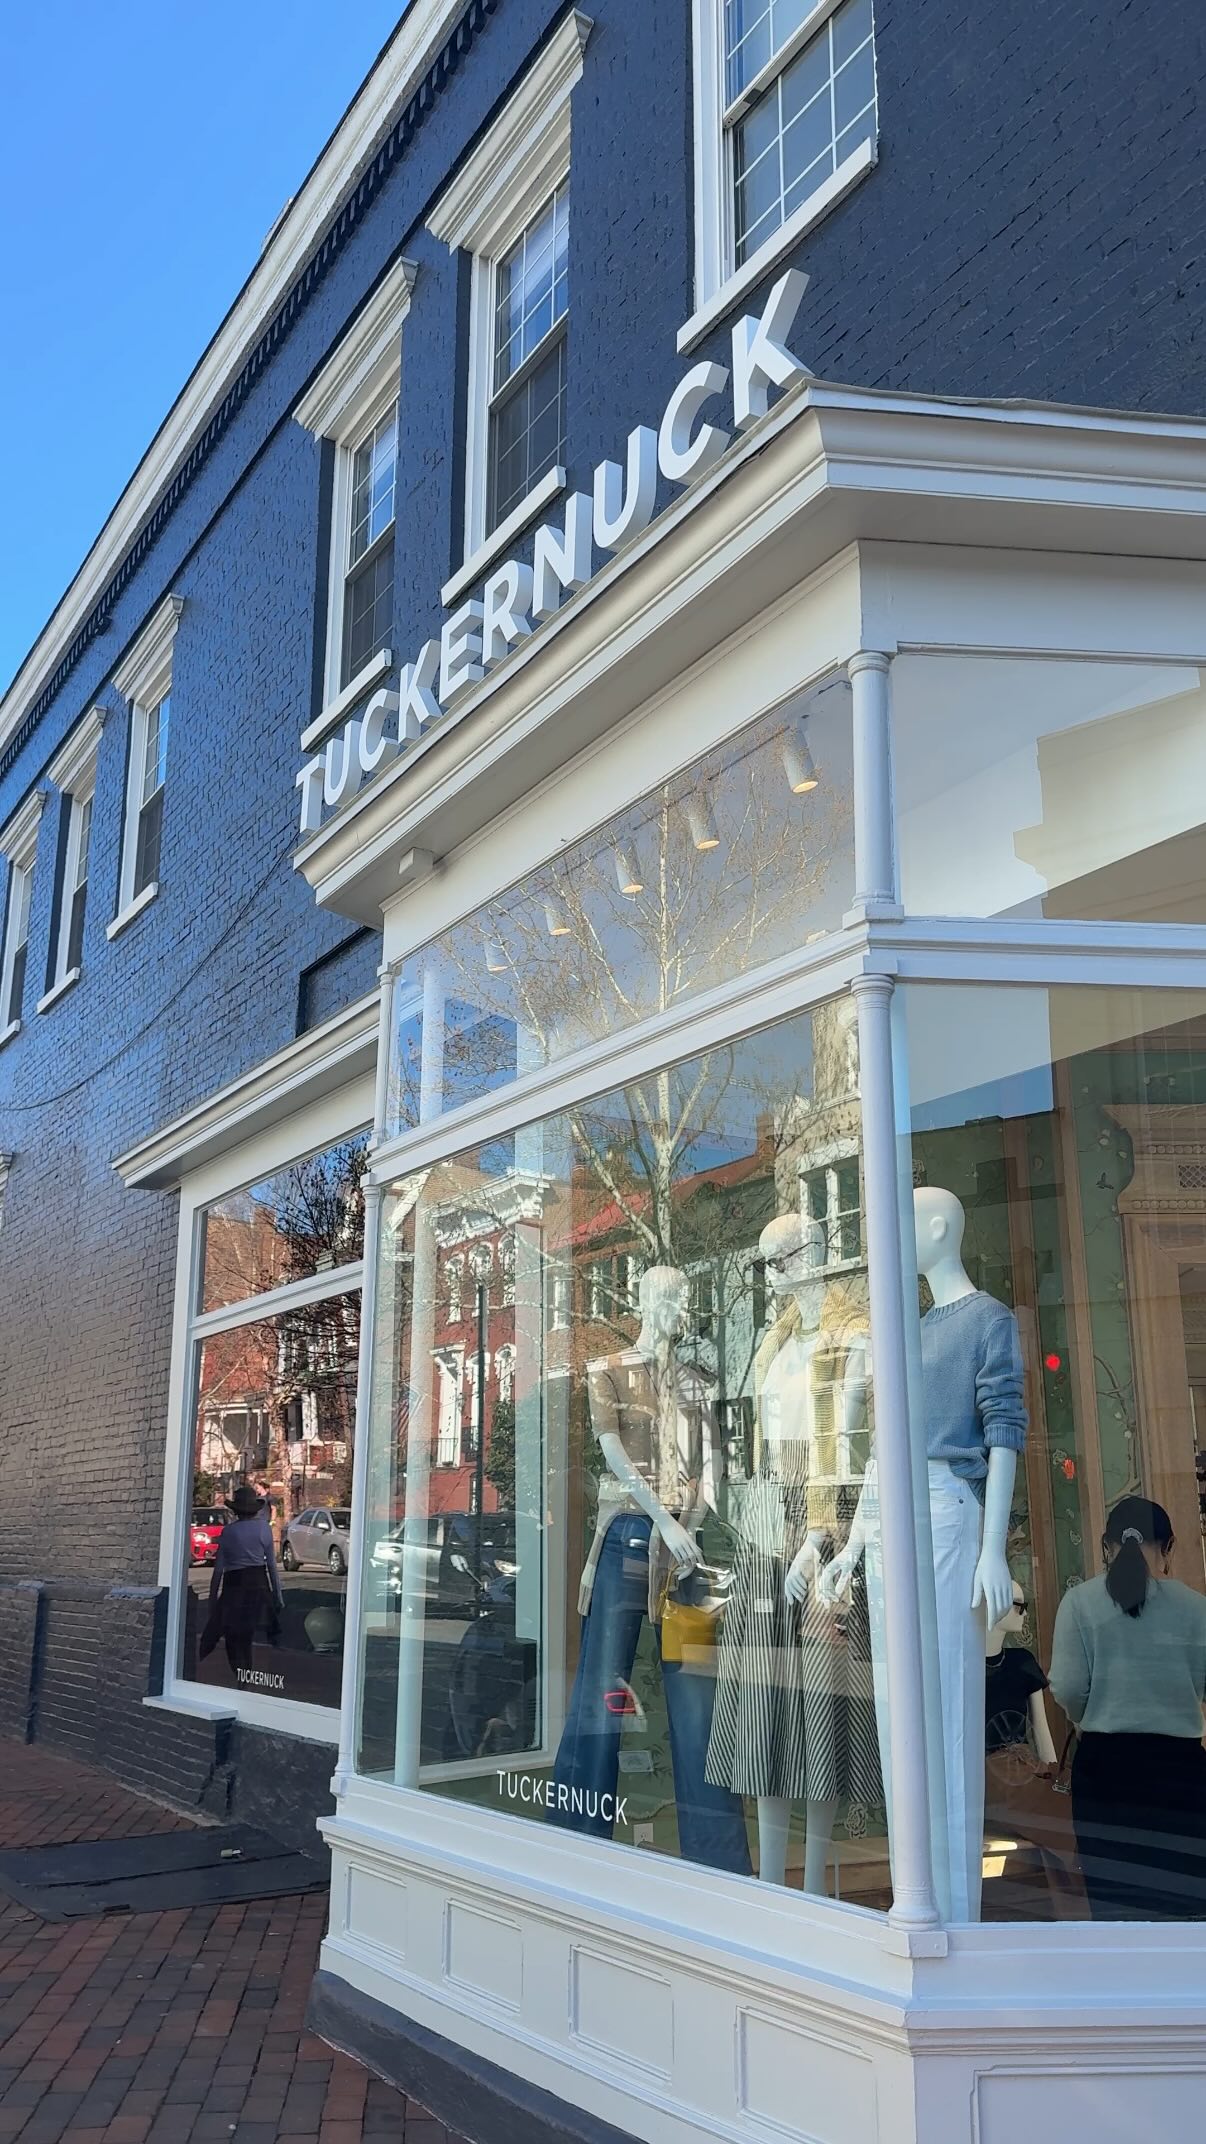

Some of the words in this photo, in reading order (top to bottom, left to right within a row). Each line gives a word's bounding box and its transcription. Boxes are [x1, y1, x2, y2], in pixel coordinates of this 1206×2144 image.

[295, 267, 815, 834] TUCKERNUCK
[236, 1668, 285, 1689] TUCKERNUCK
[496, 1770, 628, 1826] TUCKERNUCK
